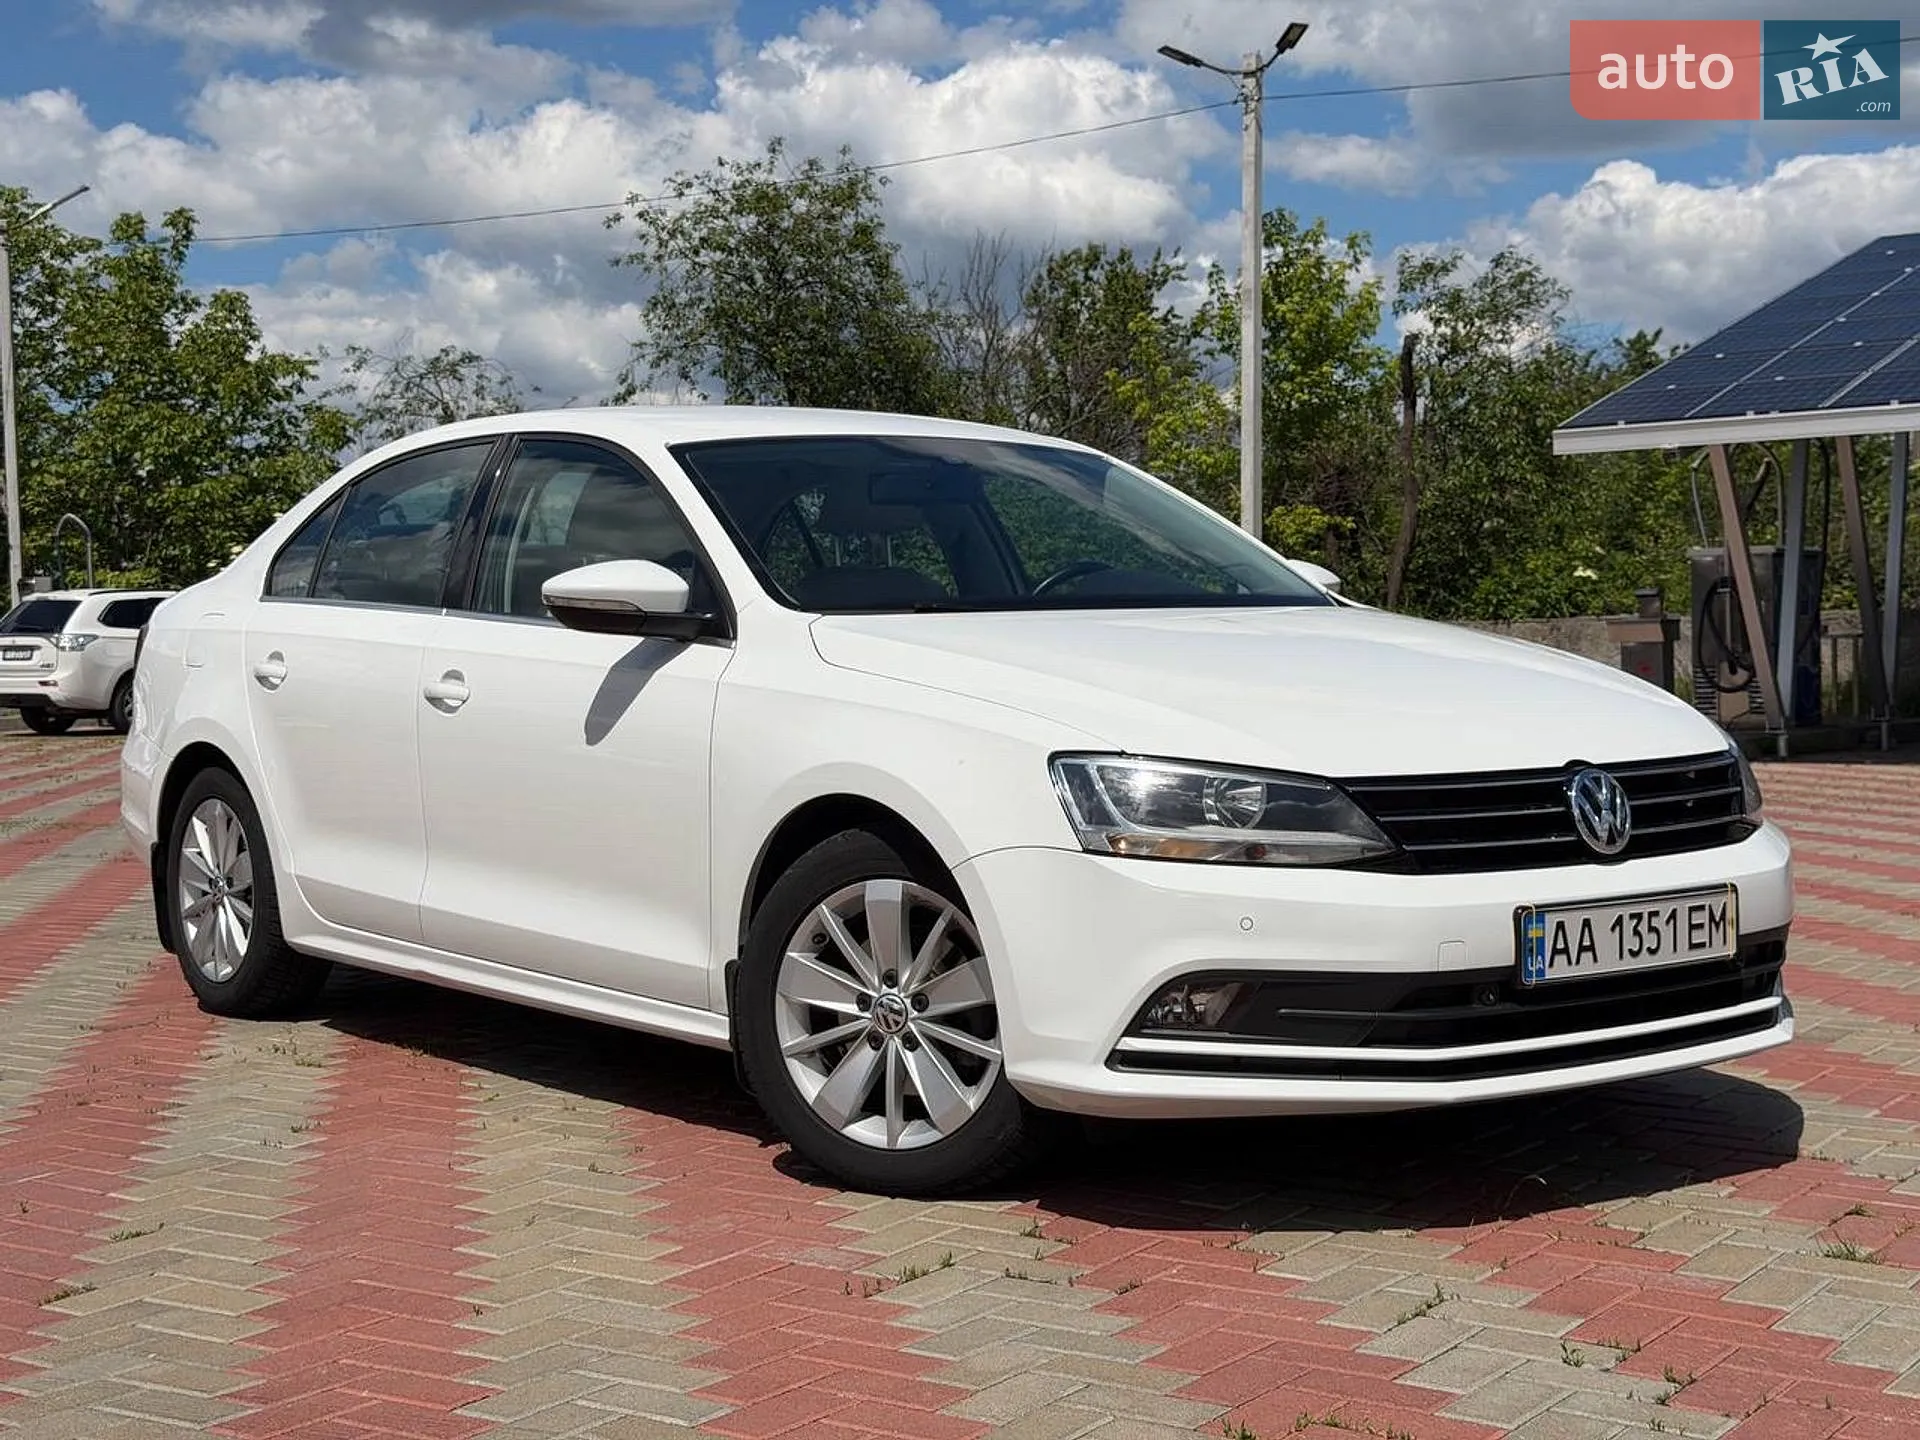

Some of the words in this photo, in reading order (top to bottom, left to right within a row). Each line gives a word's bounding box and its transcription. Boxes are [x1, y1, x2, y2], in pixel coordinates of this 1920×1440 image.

[1548, 918, 1598, 968] AA
[1610, 908, 1678, 960] 1351
[1688, 900, 1727, 950] EM
